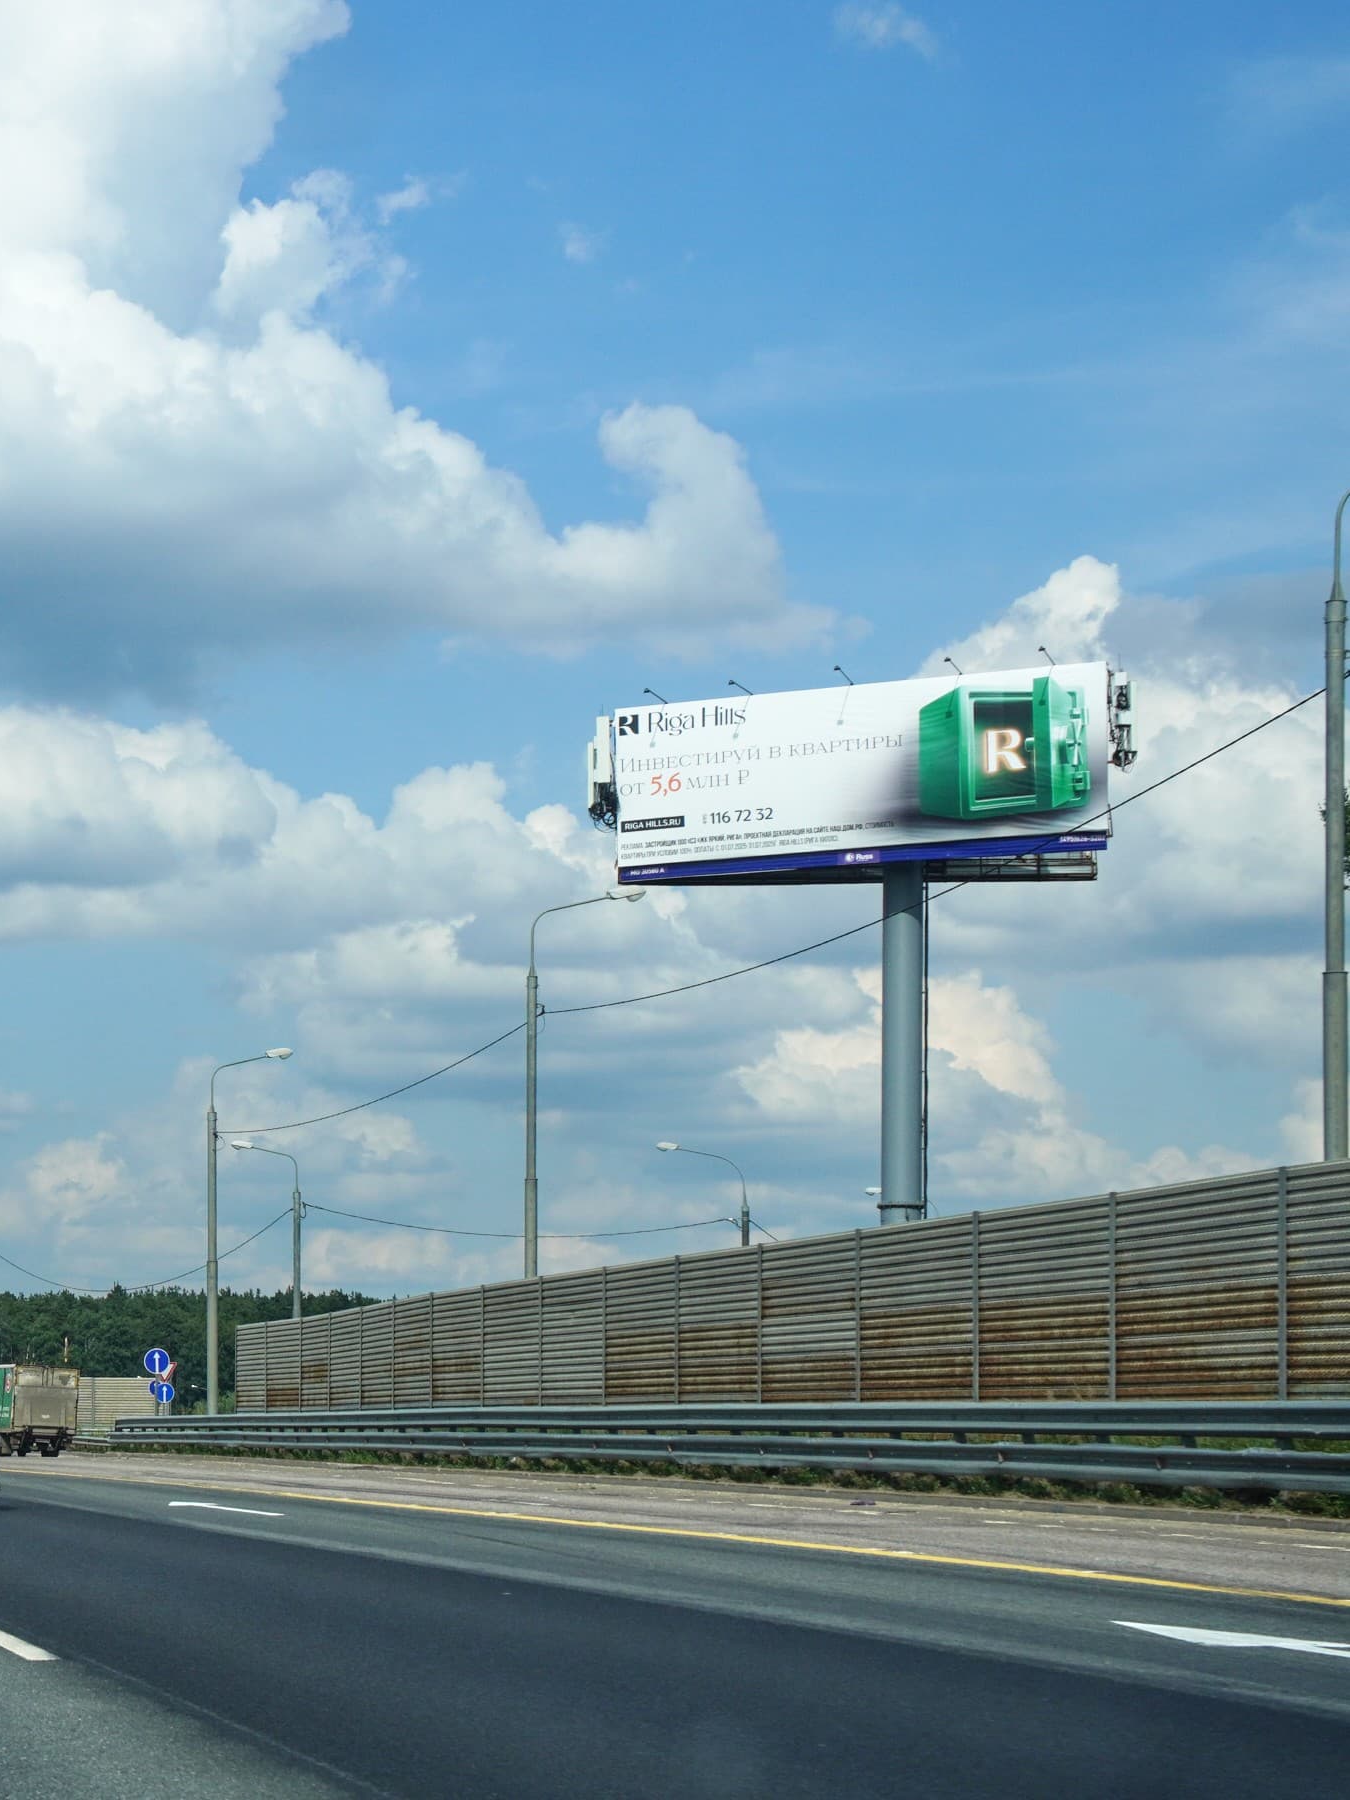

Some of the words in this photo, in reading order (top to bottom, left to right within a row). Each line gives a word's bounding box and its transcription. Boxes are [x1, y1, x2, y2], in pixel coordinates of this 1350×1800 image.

[648, 711, 695, 736] Riga
[701, 705, 746, 727] Hills
[788, 734, 903, 757] КВАРТИРЫ
[650, 772, 682, 796] 5,6
[686, 774, 730, 790] МЛН
[624, 822, 644, 831] RIGA
[645, 818, 682, 828] HILLS.RU
[710, 811, 731, 824] 116
[734, 809, 752, 822] 72
[755, 807, 774, 821] 32
